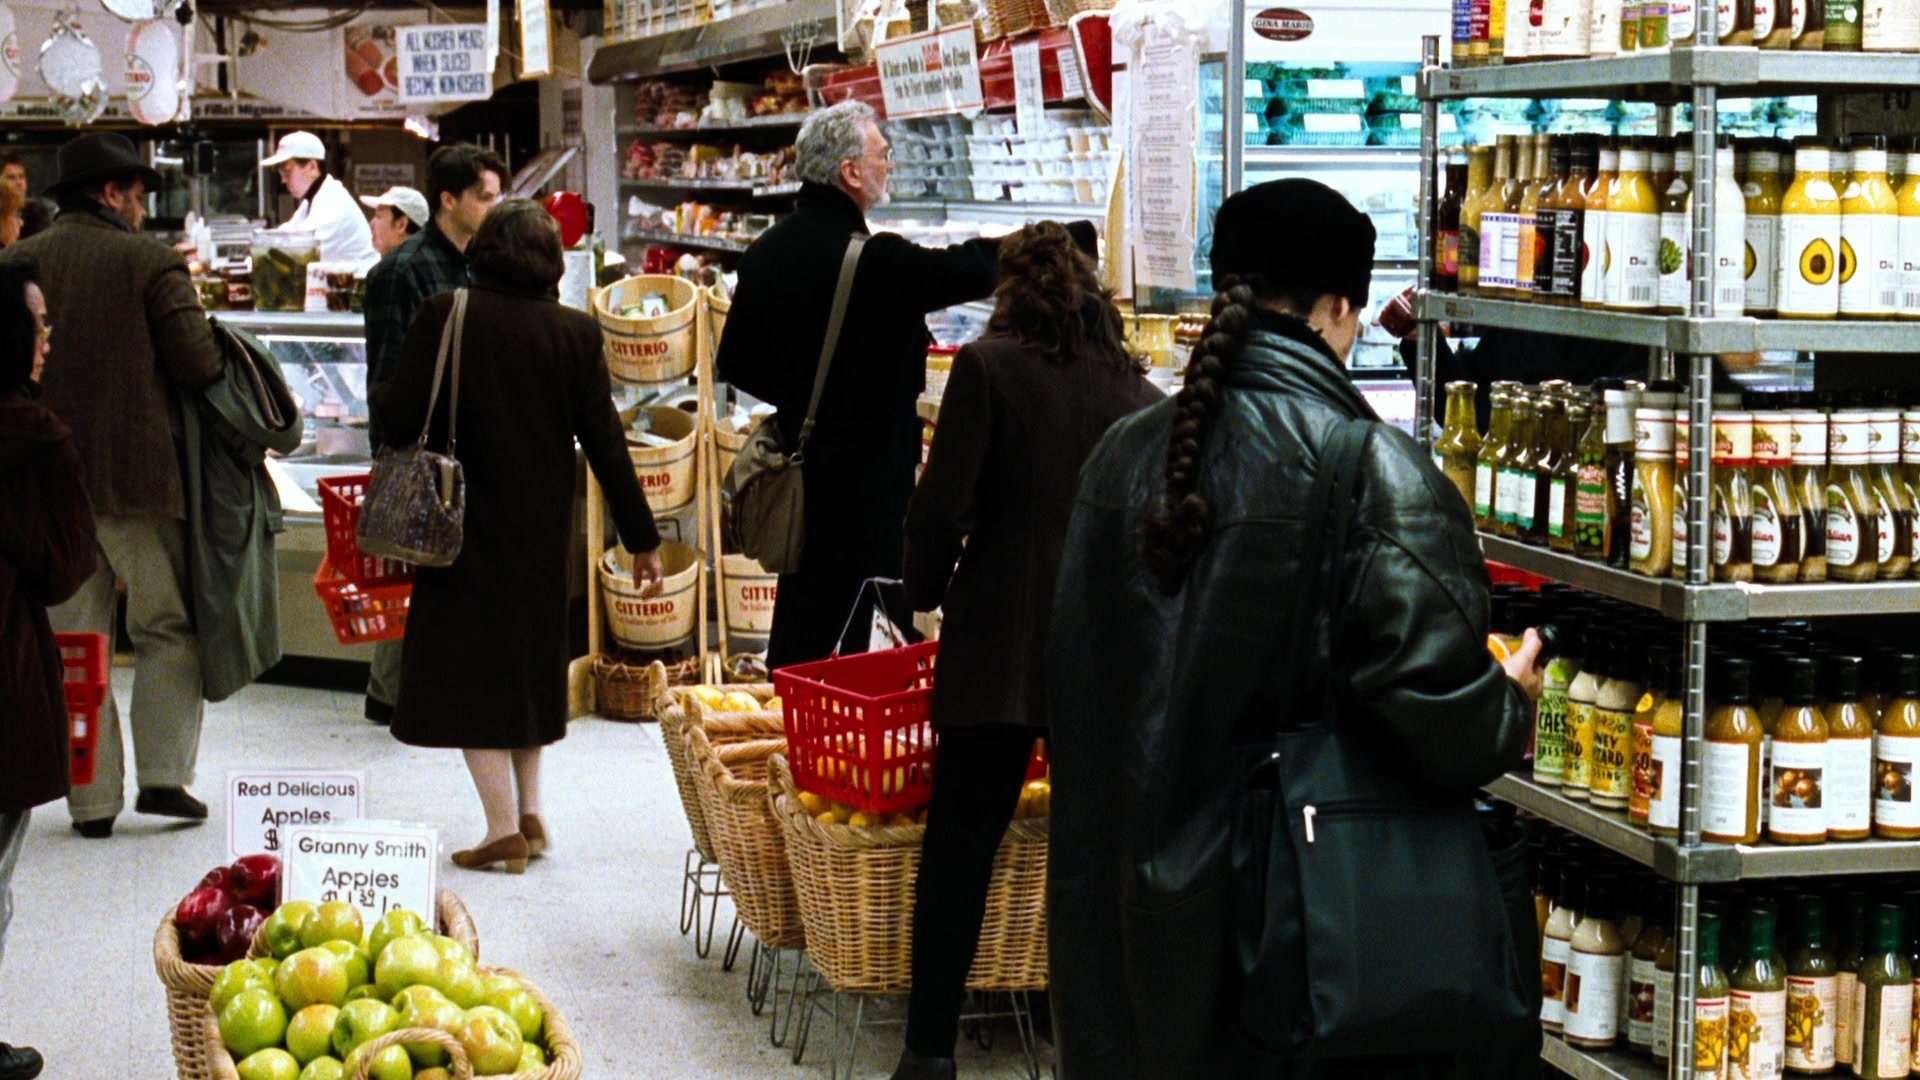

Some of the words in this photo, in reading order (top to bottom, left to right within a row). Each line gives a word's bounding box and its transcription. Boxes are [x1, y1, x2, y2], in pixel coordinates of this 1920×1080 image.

[1255, 20, 1279, 28] GINA
[406, 31, 420, 51] ALL
[423, 30, 456, 50] KOSHER
[458, 29, 484, 49] MEATS
[412, 54, 437, 72] WHEN
[441, 52, 471, 72] SLICED
[405, 75, 435, 96] BECOME
[238, 104, 283, 118] Mignon
[611, 339, 669, 357] CITTERIO
[639, 472, 671, 488] ERIO
[741, 586, 777, 600] CITTE
[615, 600, 675, 617] CITTERIO
[1538, 711, 1567, 733] CAES
[238, 782, 271, 796] Red
[278, 781, 355, 796] Delicious
[262, 807, 331, 827] Apples
[298, 836, 369, 859] Granny
[375, 840, 426, 859] Smith
[322, 867, 399, 890] Apples
